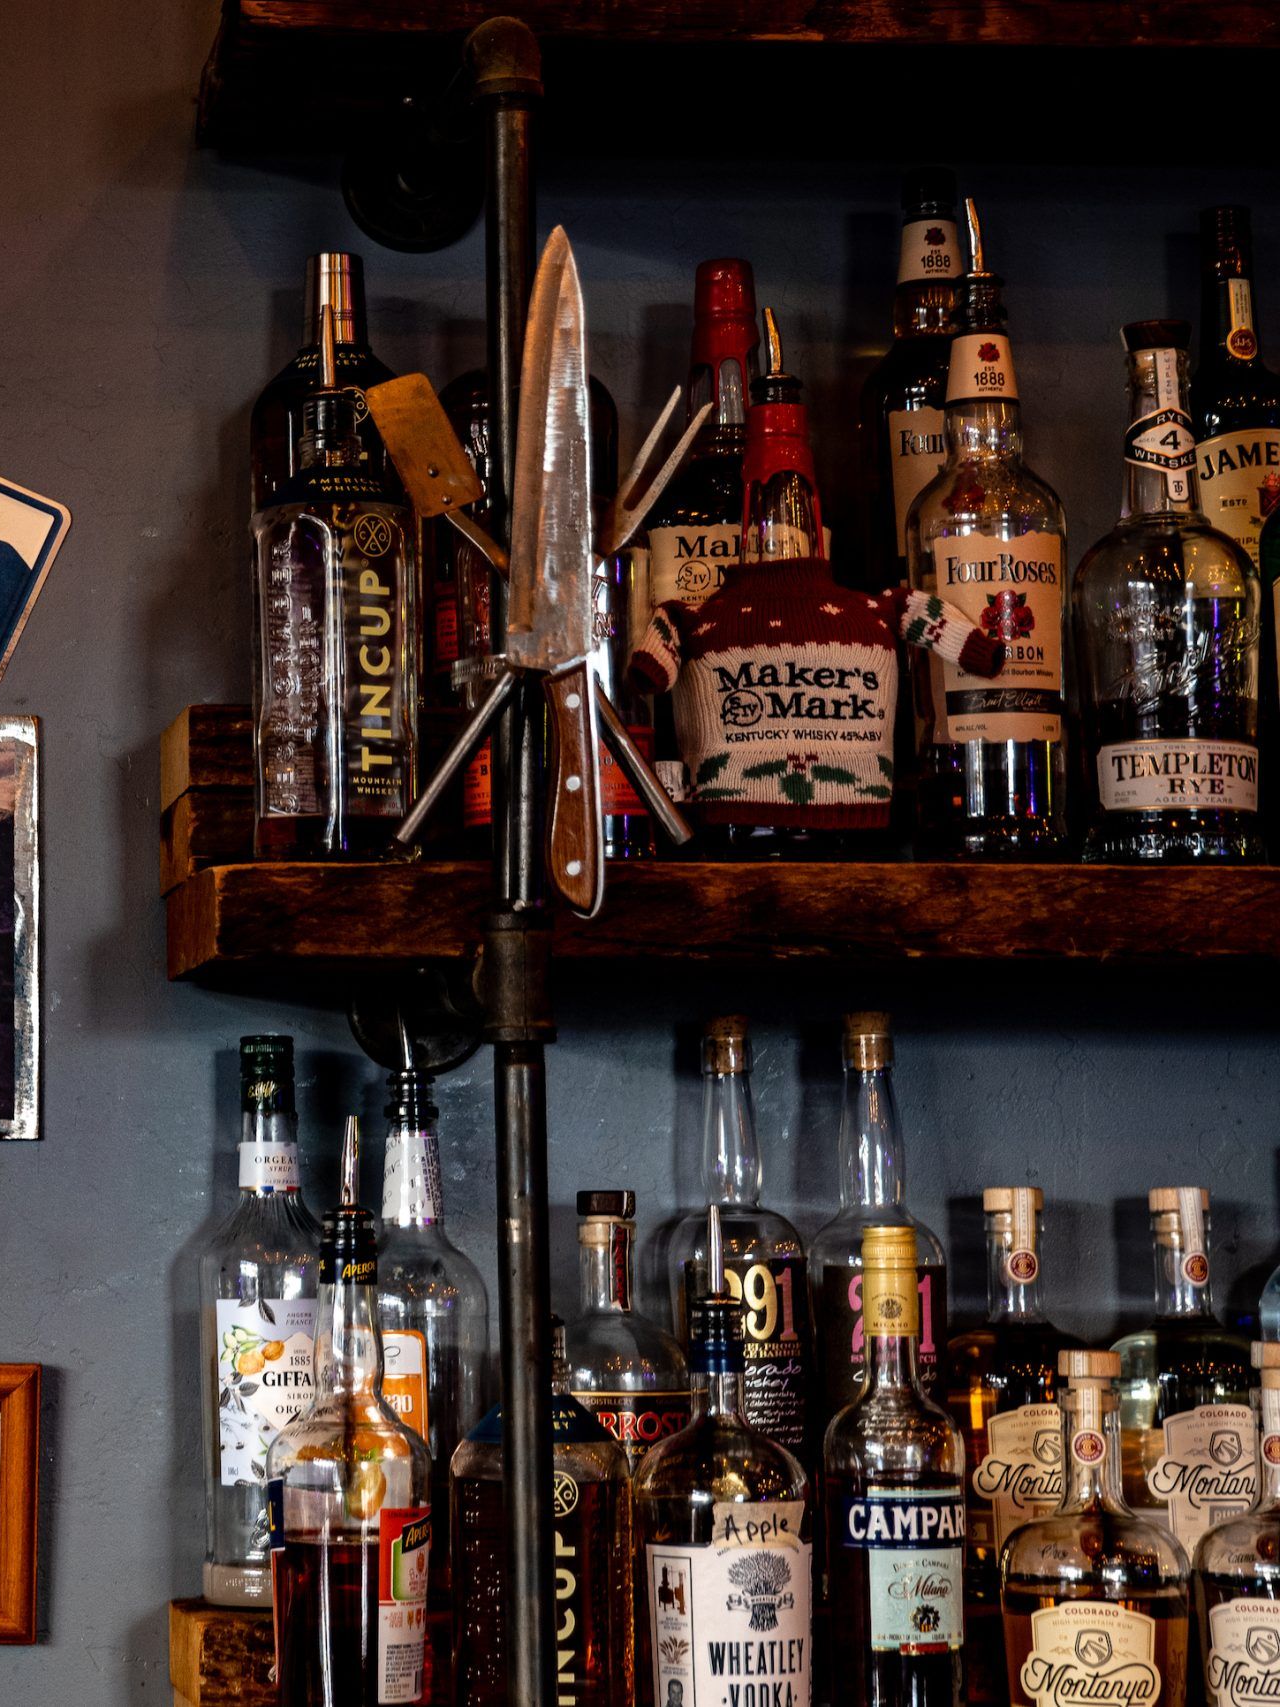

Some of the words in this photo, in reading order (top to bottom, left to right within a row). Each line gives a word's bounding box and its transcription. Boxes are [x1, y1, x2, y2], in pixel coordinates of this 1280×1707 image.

[921, 255, 951, 268] 1888
[974, 372, 1006, 386] 1888
[1156, 412, 1185, 425] RYE
[1159, 430, 1181, 450] 4
[1134, 448, 1195, 468] WHISKE
[1200, 442, 1280, 481] JAME
[945, 555, 997, 586] Four
[998, 552, 1057, 585] Roses
[358, 569, 393, 773] TINCUP
[712, 661, 880, 693] Maker's
[725, 729, 790, 744] KENTUCKY
[792, 729, 839, 741] WHISKY
[1111, 752, 1257, 784] TEMPLETON
[352, 776, 403, 786] MOUNTAIN
[1167, 778, 1225, 795] RYE
[356, 786, 398, 795] WHISKEY
[285, 1318, 313, 1326] FRANCE
[289, 1355, 311, 1367] 1885
[261, 1370, 312, 1387] GIFFA
[1023, 1408, 1060, 1418] COLORA
[1199, 1410, 1248, 1420] COLORADO
[977, 1460, 1062, 1509] Monta
[723, 1512, 790, 1546] Apple
[848, 1503, 966, 1541] CAMPAR
[1064, 1607, 1119, 1618] COLORADO
[1234, 1605, 1280, 1615] COLORAD
[707, 1637, 805, 1678] WHEATLEY
[1024, 1657, 1156, 1707] Montanya
[1210, 1655, 1280, 1707] Monta
[726, 1681, 794, 1707] VODKA
